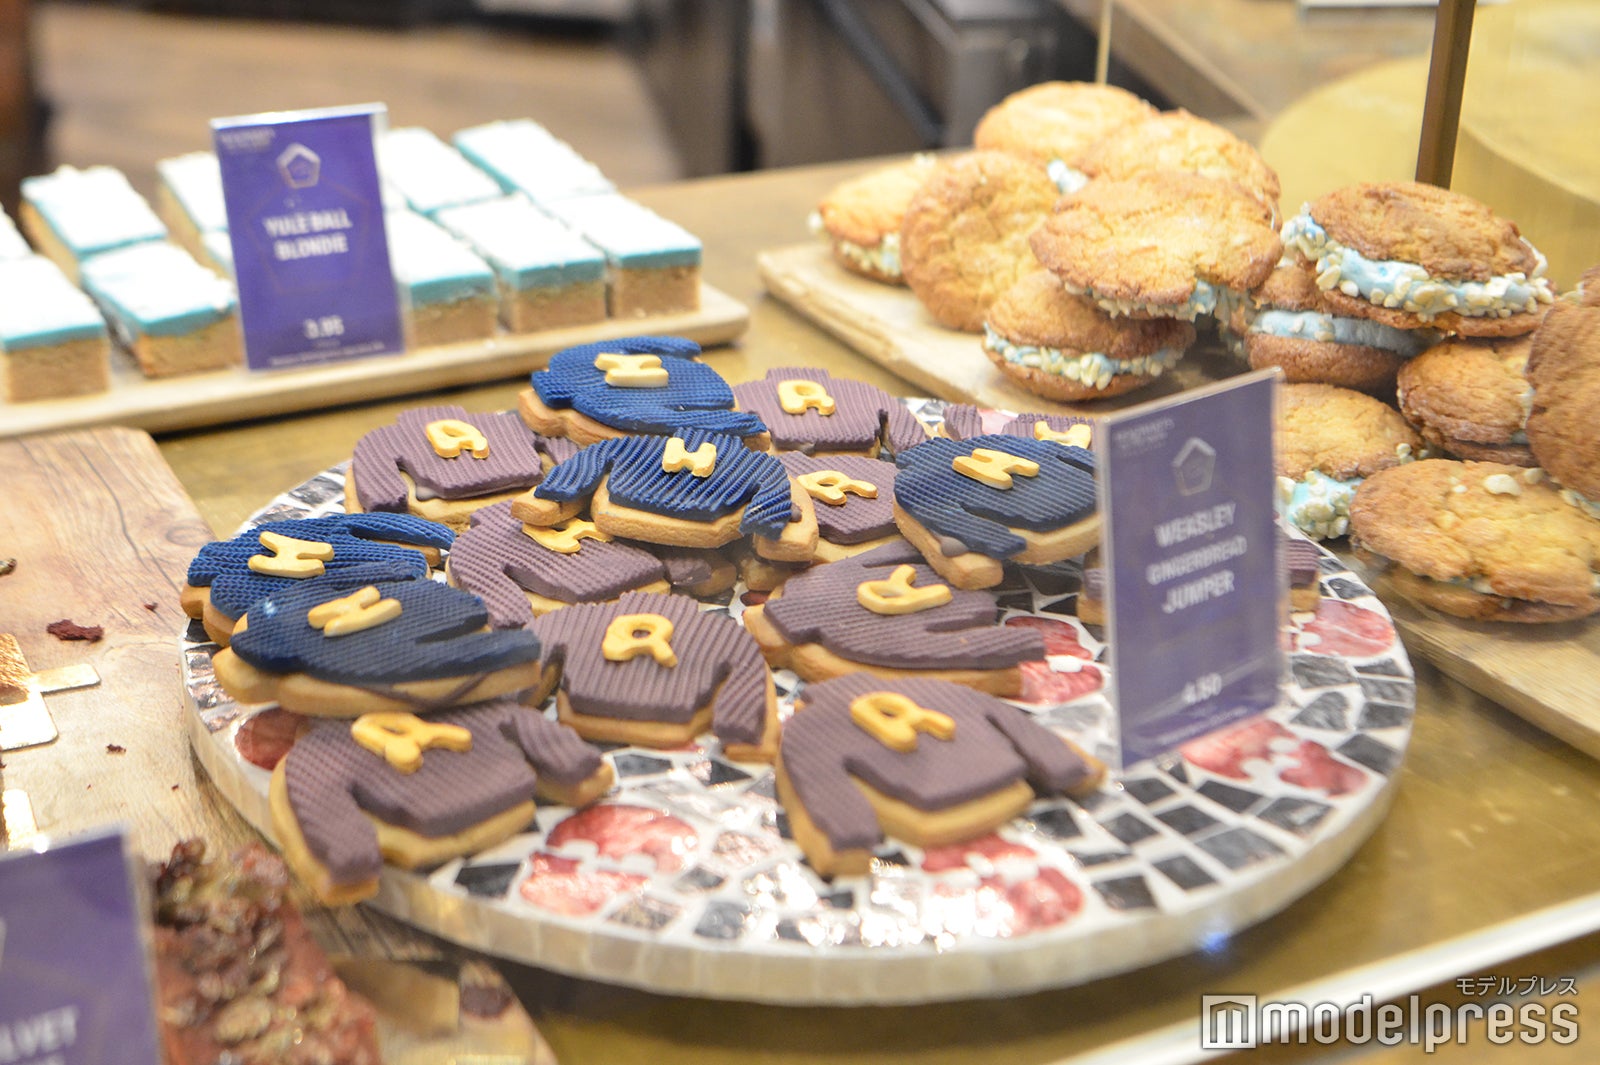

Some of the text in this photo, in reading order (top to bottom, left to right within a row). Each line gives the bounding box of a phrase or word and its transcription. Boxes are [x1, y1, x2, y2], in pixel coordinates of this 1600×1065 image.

[263, 208, 353, 237] YULE BALL
[274, 232, 349, 261] BLONDIE
[1153, 501, 1236, 548] WEASLEY
[1146, 534, 1247, 585] GINGERBREAD
[1161, 569, 1235, 614] JUMPER
